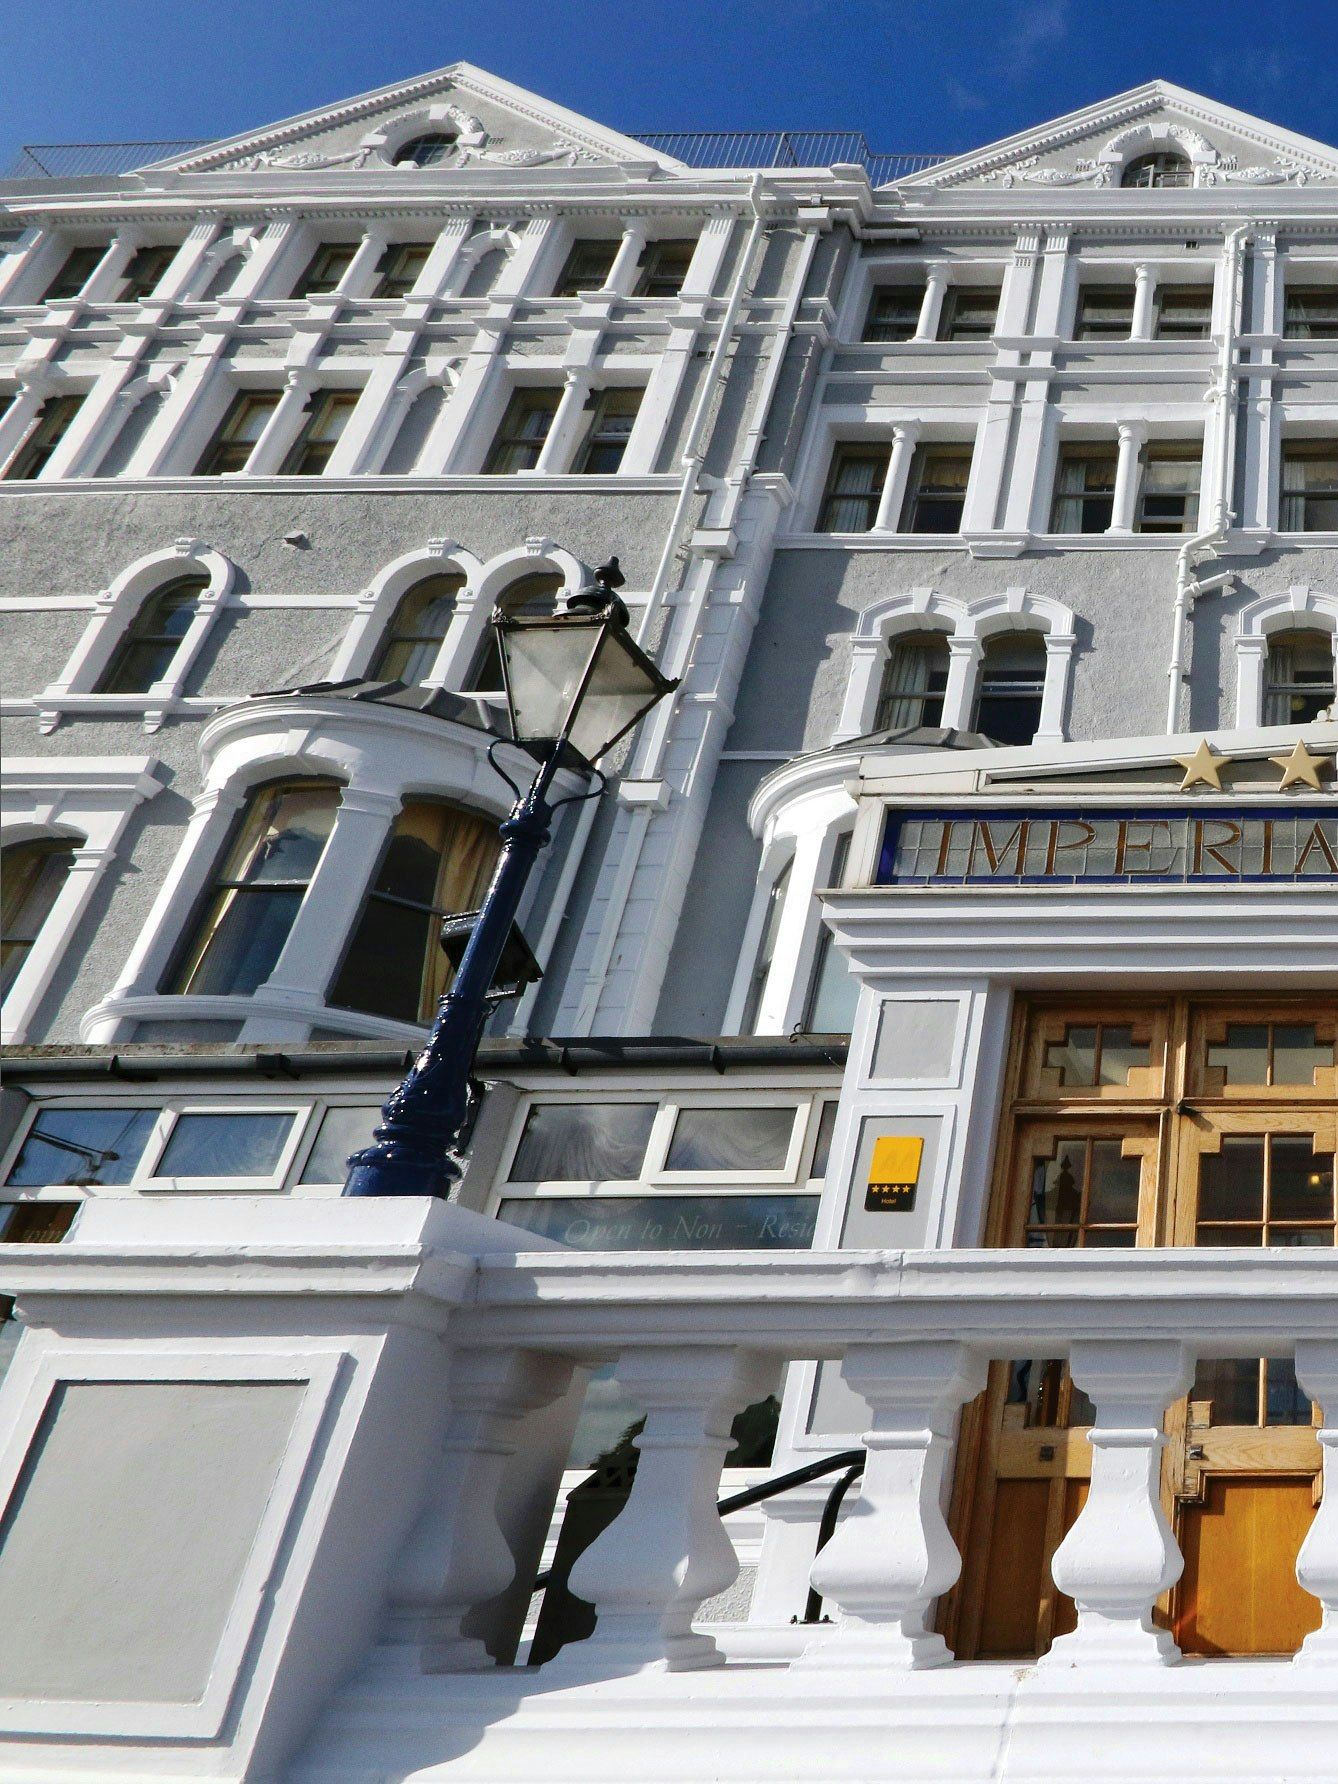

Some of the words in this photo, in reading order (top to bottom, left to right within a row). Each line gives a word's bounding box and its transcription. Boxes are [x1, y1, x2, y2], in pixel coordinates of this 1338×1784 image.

[564, 1219, 632, 1246] Open
[641, 1216, 662, 1240] to
[673, 1215, 722, 1240] Non
